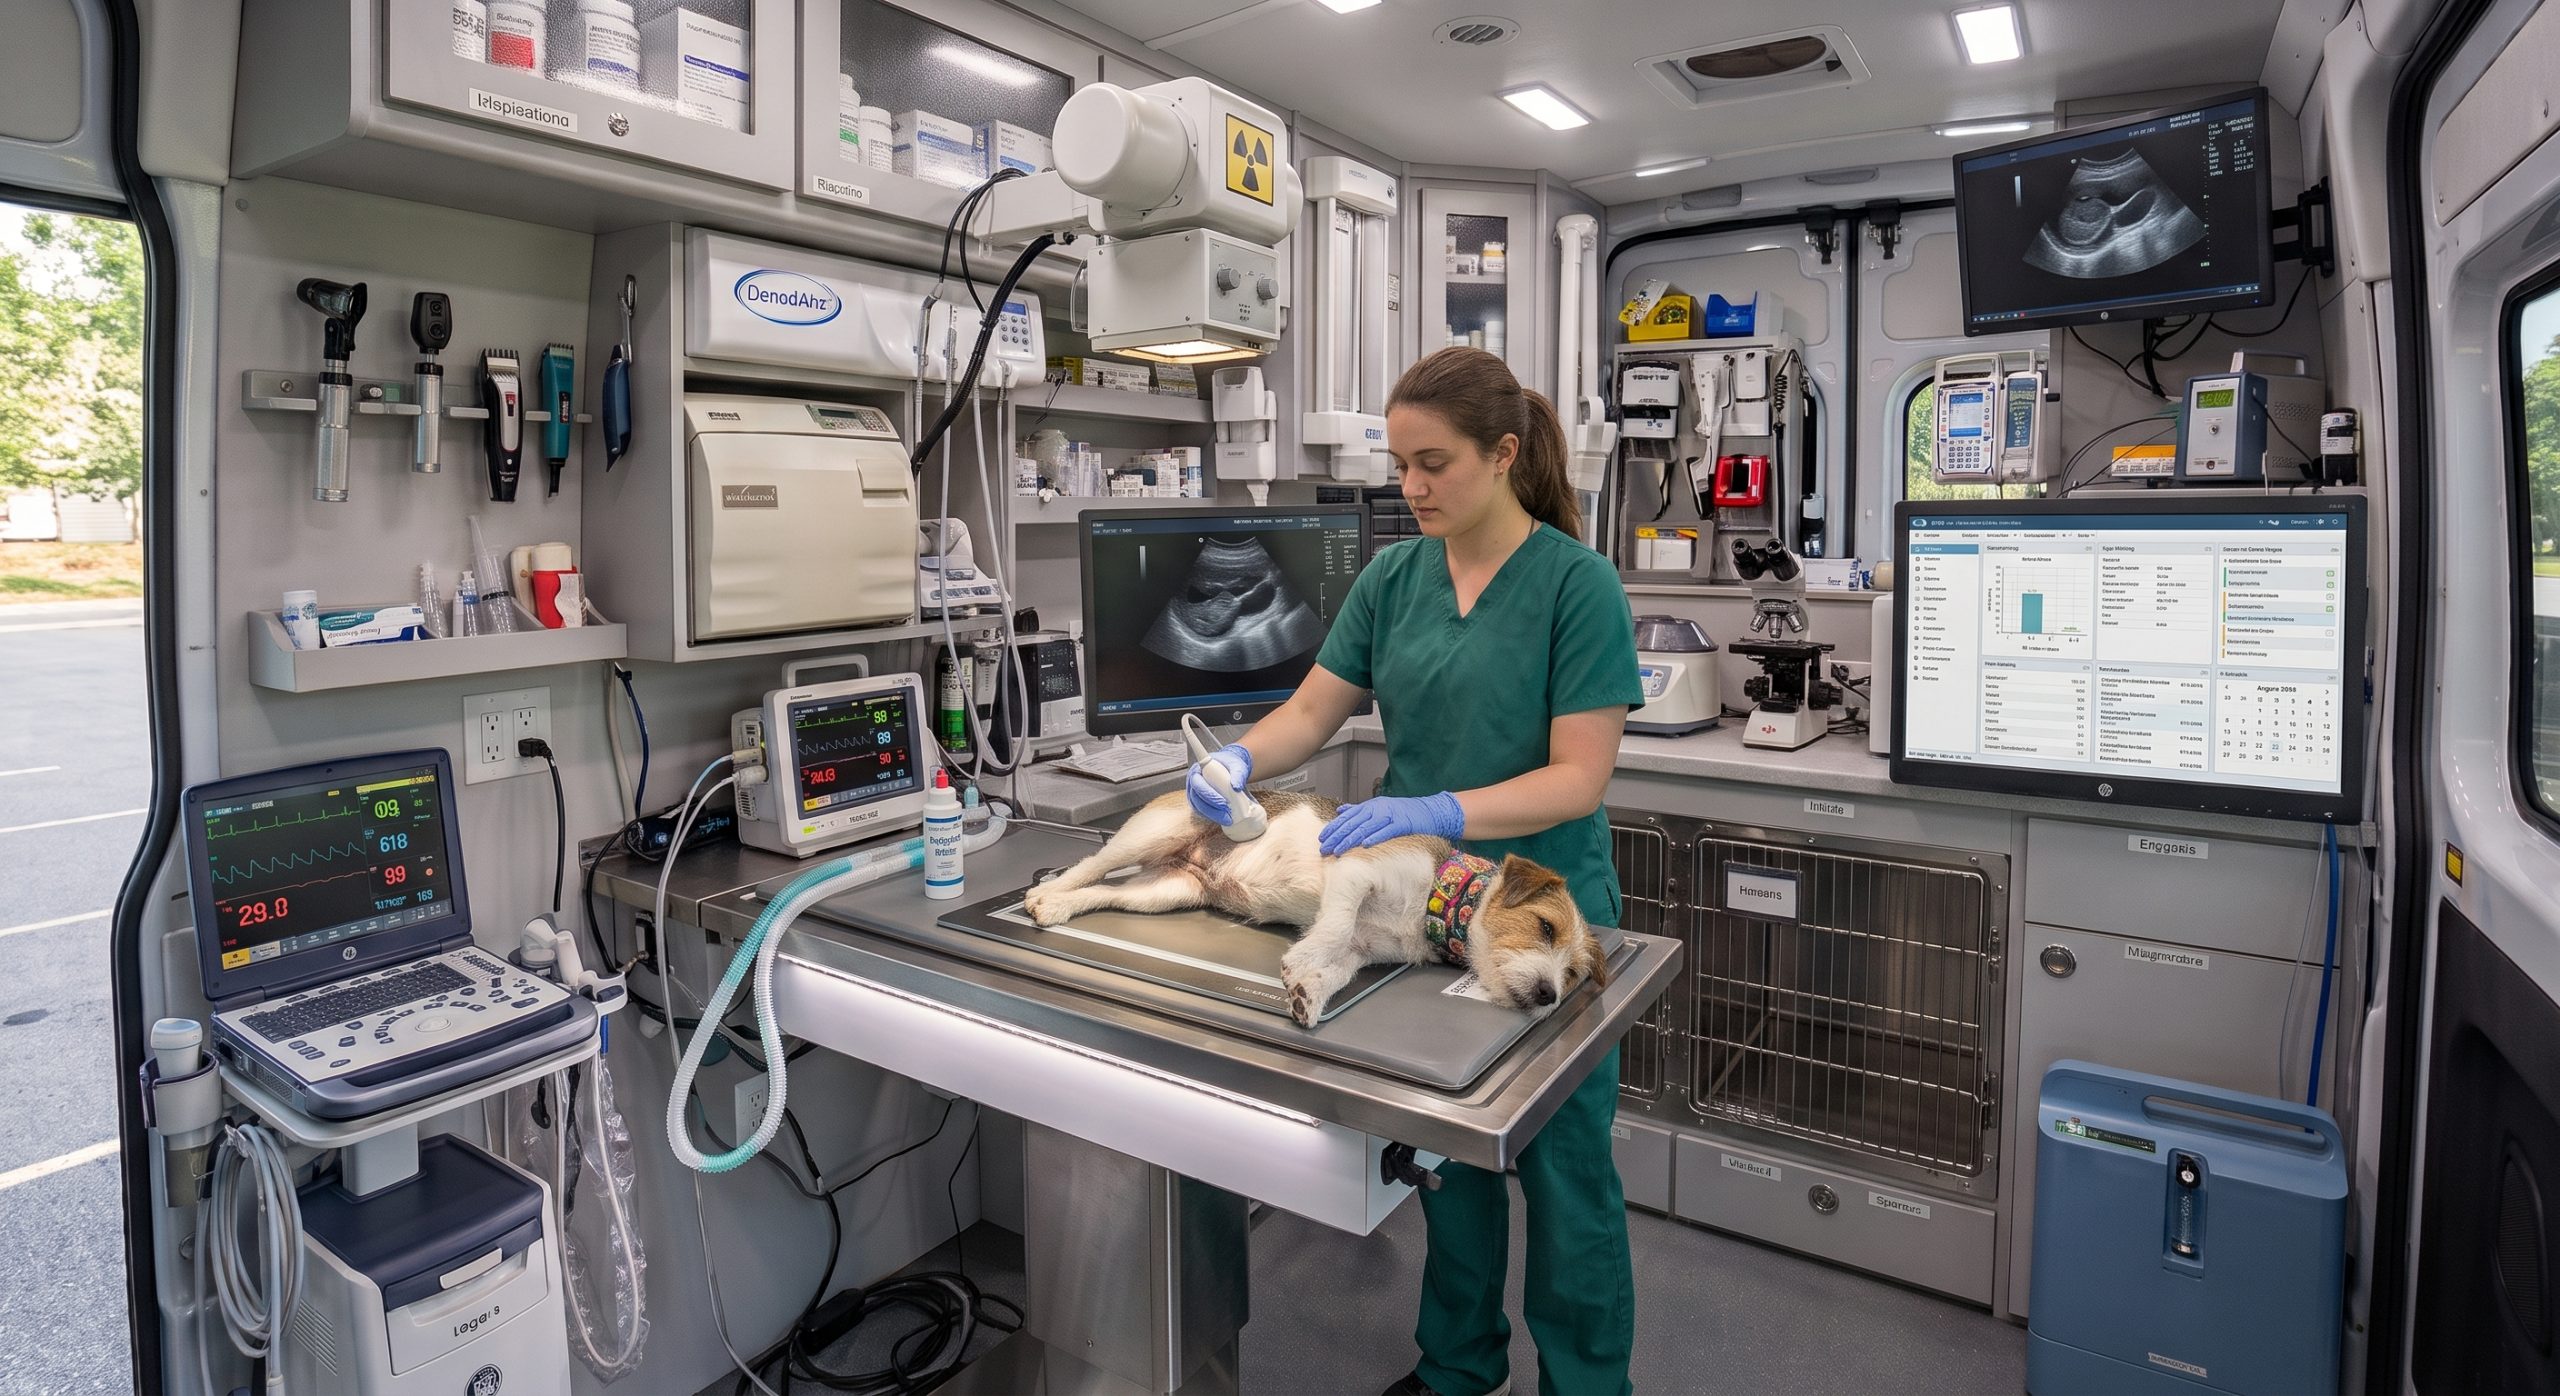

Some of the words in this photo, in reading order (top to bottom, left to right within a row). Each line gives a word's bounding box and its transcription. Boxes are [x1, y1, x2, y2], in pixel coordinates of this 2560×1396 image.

[747, 284, 827, 310] DenodAhz
[380, 833, 408, 852] 618
[384, 866, 406, 885] 99
